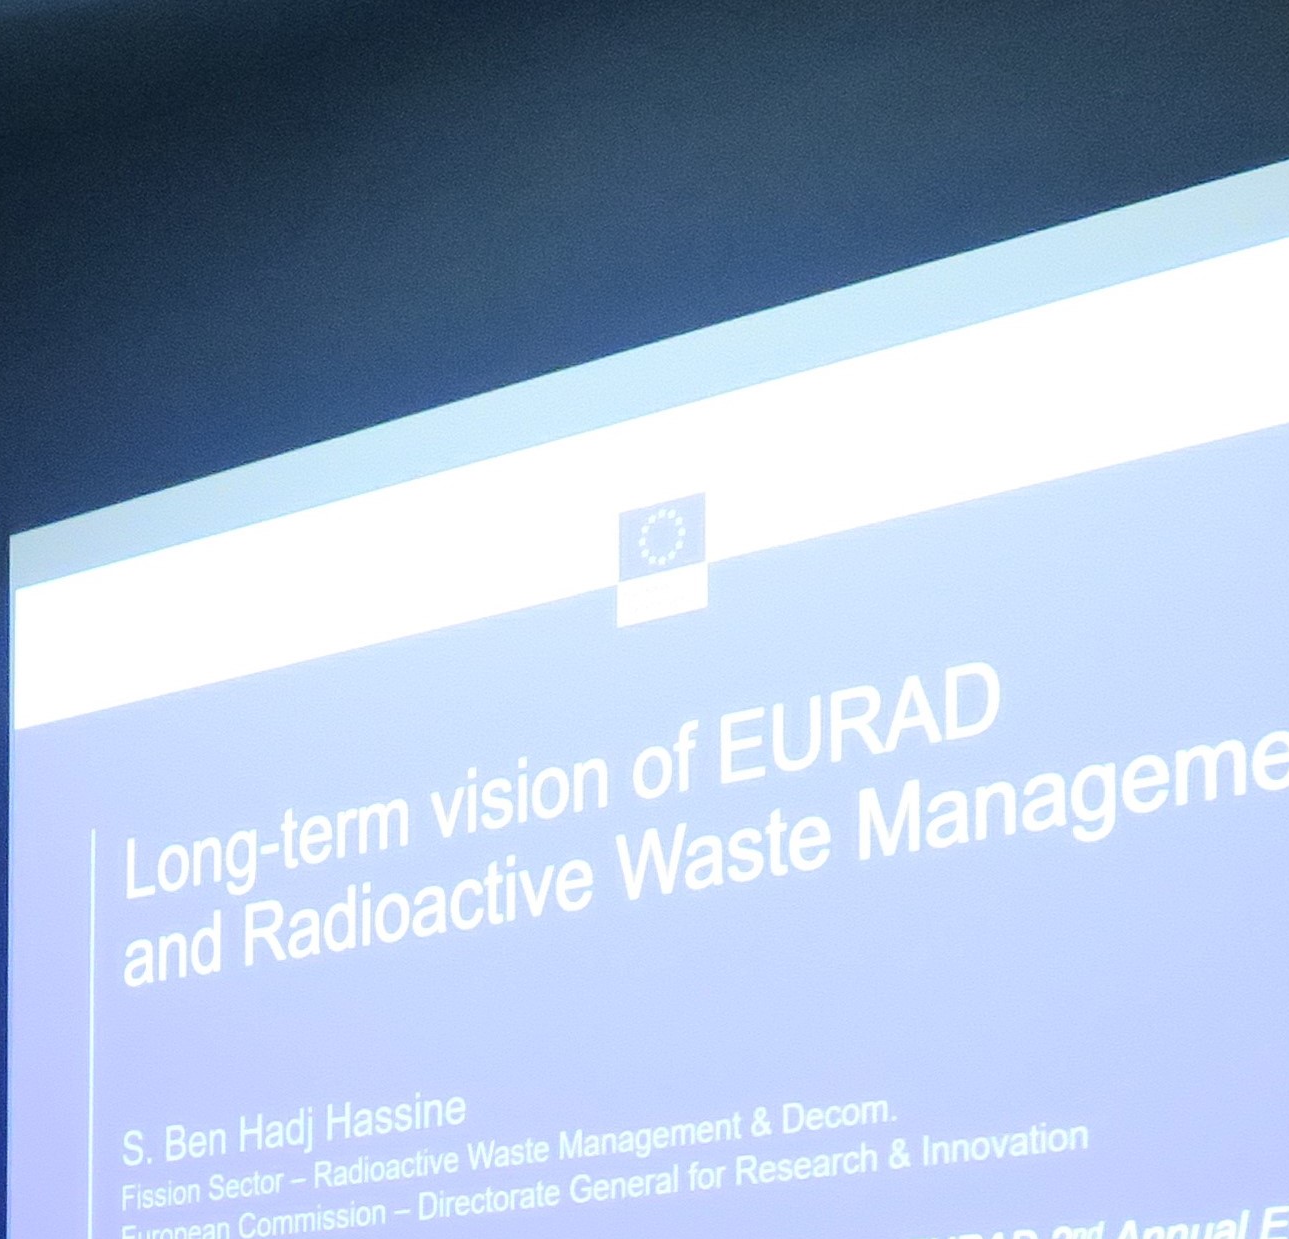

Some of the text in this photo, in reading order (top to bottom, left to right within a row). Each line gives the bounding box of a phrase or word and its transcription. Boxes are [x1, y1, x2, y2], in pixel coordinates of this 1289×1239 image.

[125, 661, 1001, 900] Long-term vision of EURAD
[123, 909, 222, 988] and
[244, 854, 594, 967] Radioactive
[615, 808, 832, 901] Waste
[121, 1183, 201, 1212] Fission
[208, 1170, 285, 1201] Sector
[314, 1150, 459, 1189] Radioactive
[466, 1137, 550, 1171] Waste
[558, 1111, 743, 1161] Management
[750, 1106, 773, 1138] &
[781, 1099, 898, 1135] Decom.
[122, 1091, 467, 1167] S. Ben Hadj Hassine
[238, 1204, 386, 1239] Commission
[418, 1180, 561, 1221] Directorate
[569, 1163, 679, 1204] General
[687, 1161, 727, 1192] for
[735, 1142, 878, 1186] Research
[888, 1137, 912, 1170] &
[922, 1124, 1089, 1167] Innovation
